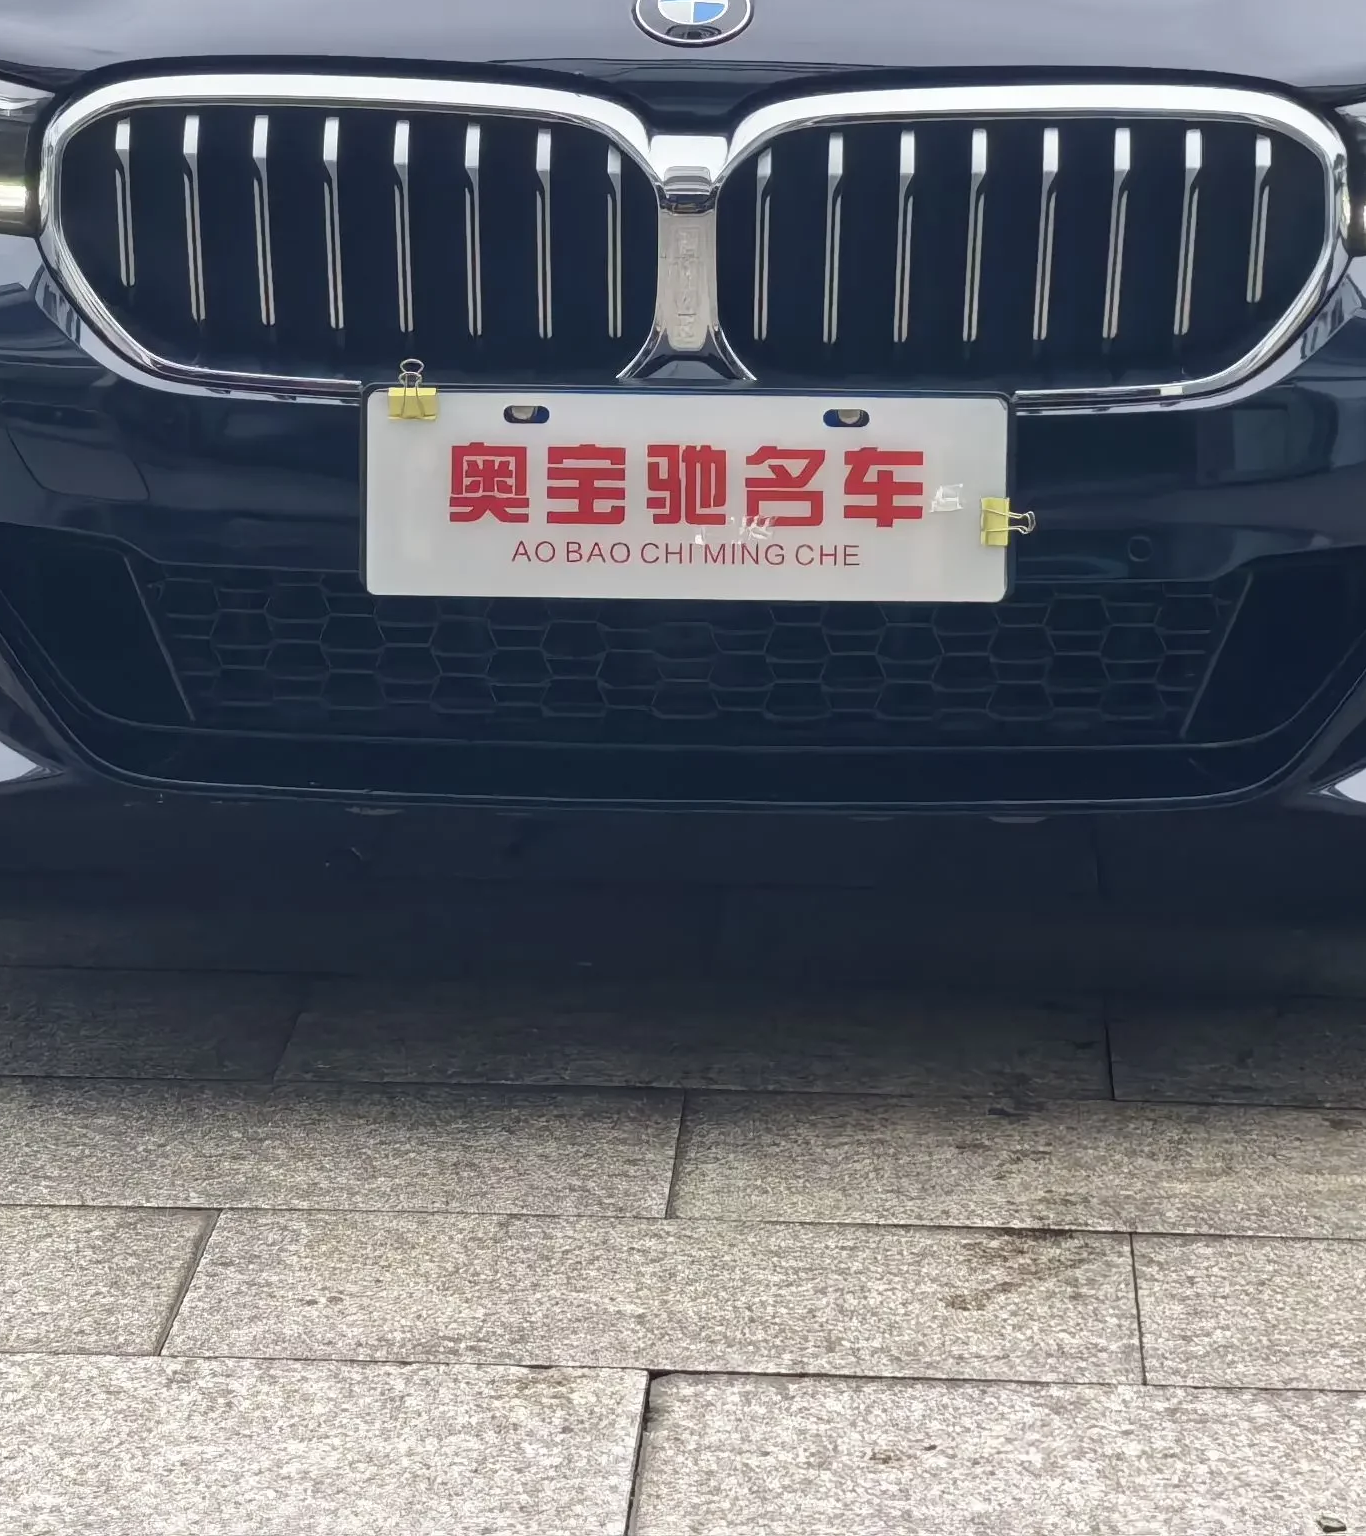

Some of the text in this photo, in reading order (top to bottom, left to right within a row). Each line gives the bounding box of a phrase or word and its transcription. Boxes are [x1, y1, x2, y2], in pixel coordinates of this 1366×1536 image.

[448, 441, 926, 529] 奥宝驰名车
[511, 540, 861, 567] AO BAO CHI MING CHE
